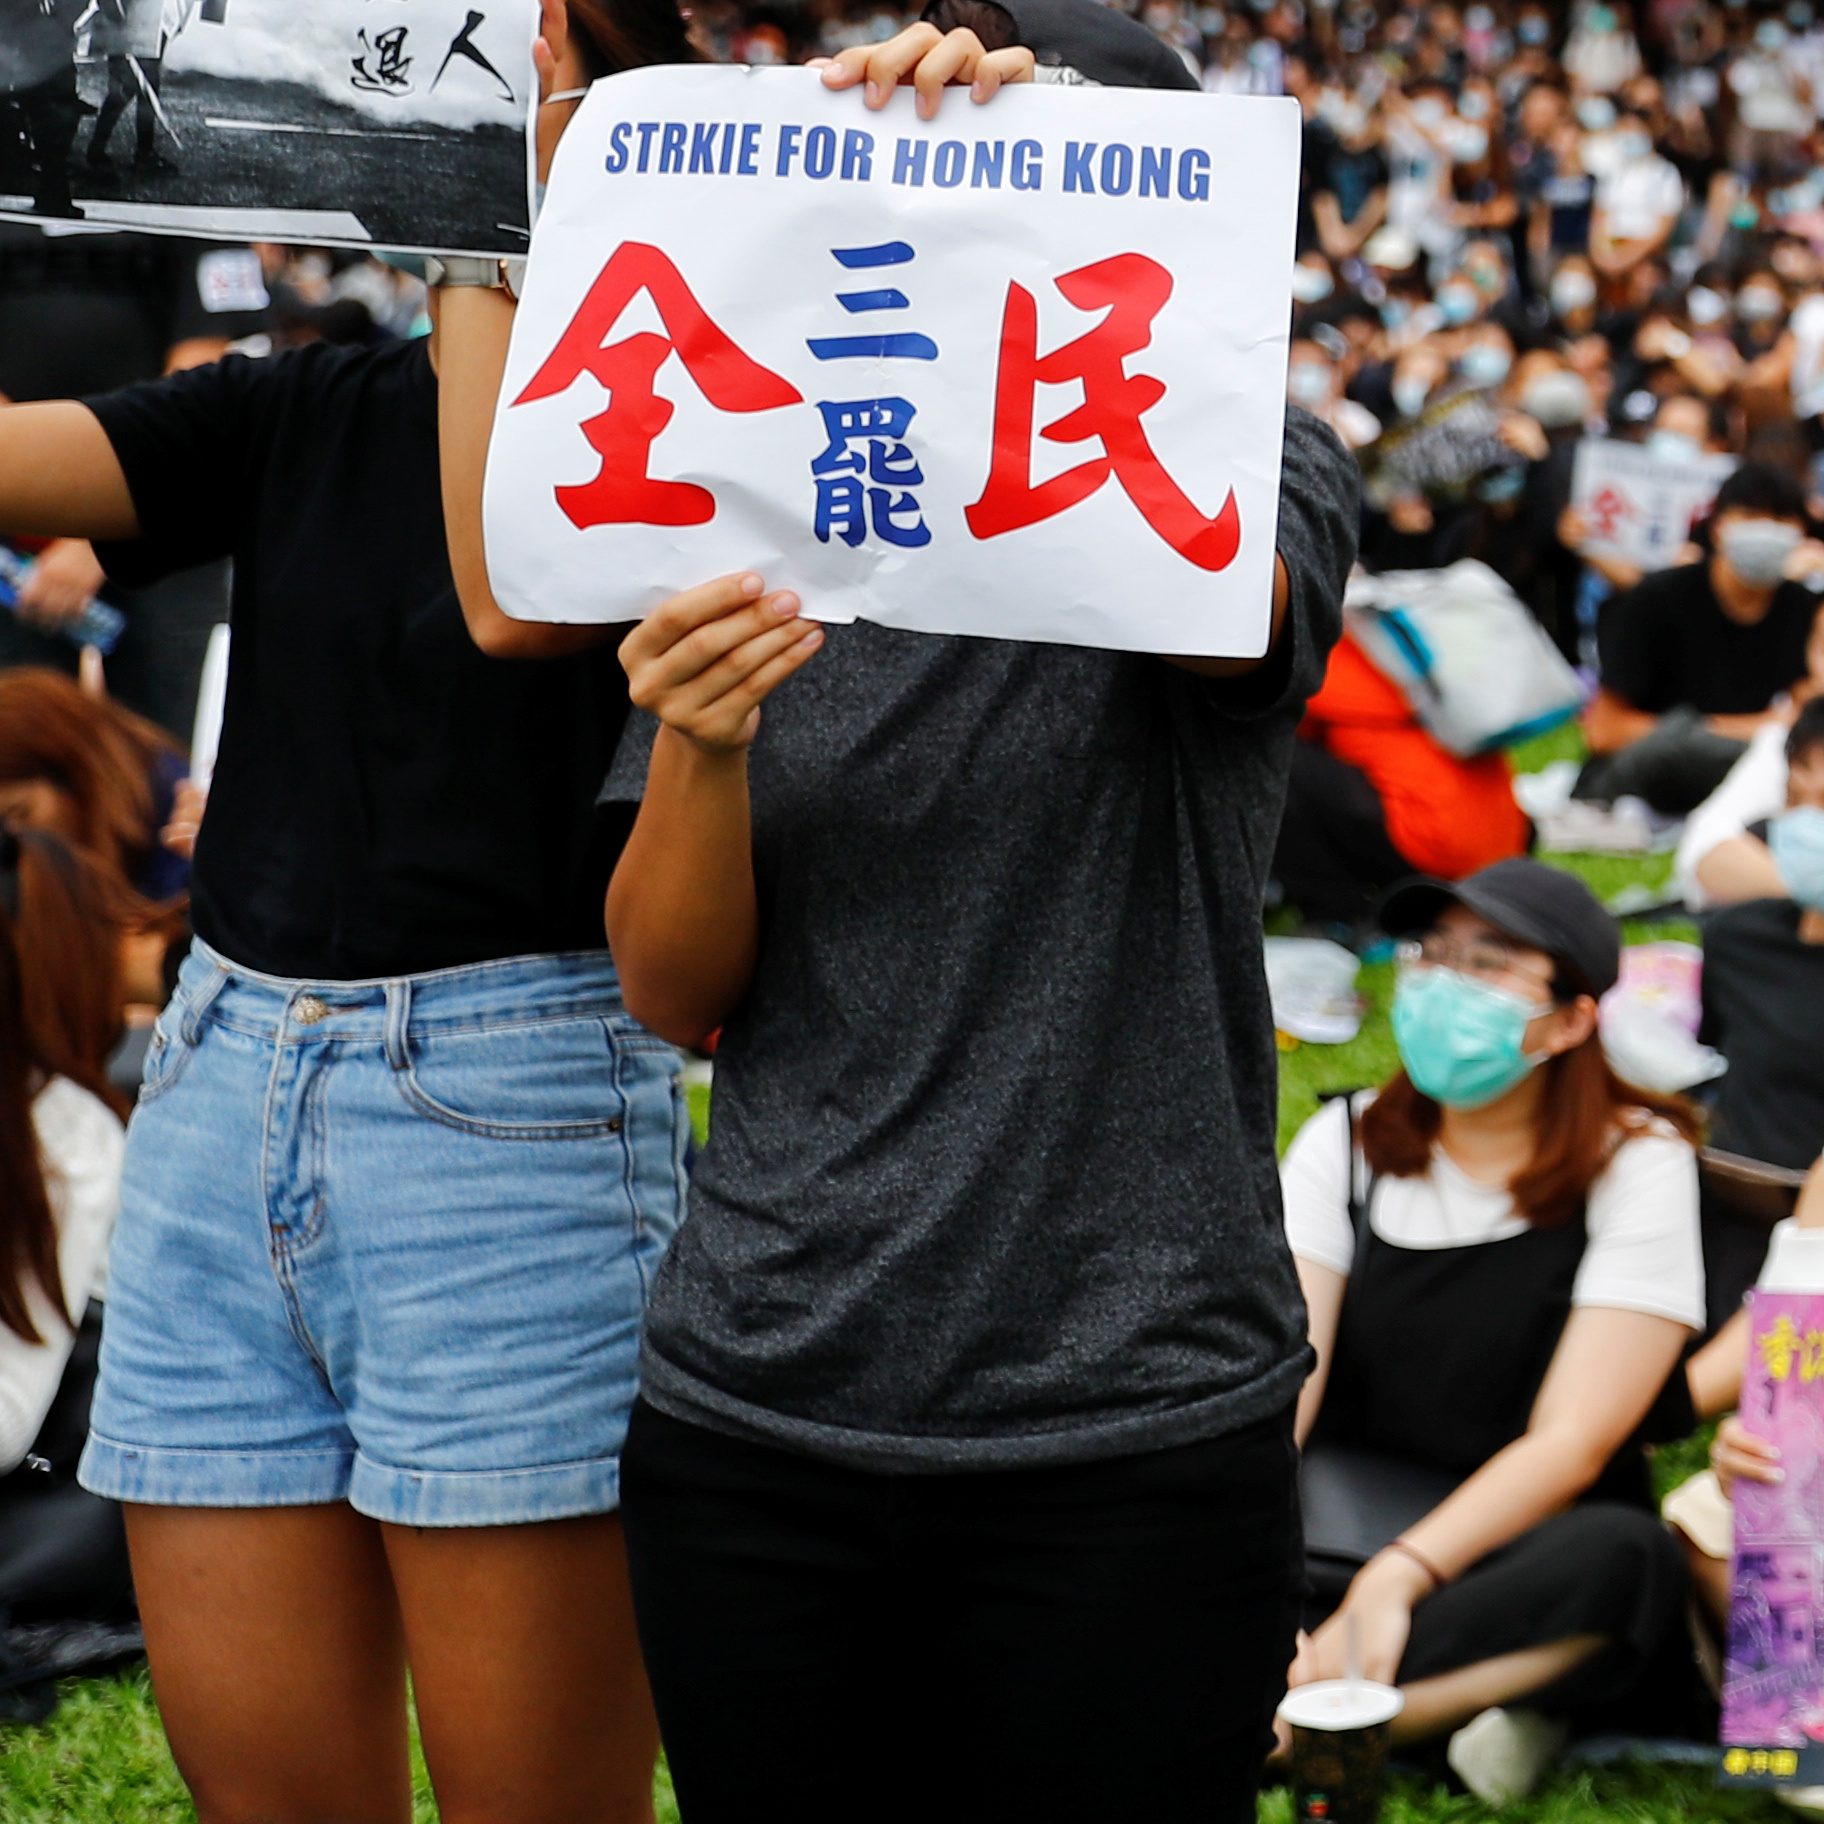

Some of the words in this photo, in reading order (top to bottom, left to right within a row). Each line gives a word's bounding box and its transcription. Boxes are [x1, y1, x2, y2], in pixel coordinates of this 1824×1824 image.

[605, 120, 763, 176] STRKIE
[776, 124, 875, 182] FOR
[892, 137, 1044, 191] HONG
[1062, 141, 1212, 202] KONG
[510, 240, 805, 531] 全
[806, 240, 939, 549] 三罷
[963, 251, 1242, 573] 民
